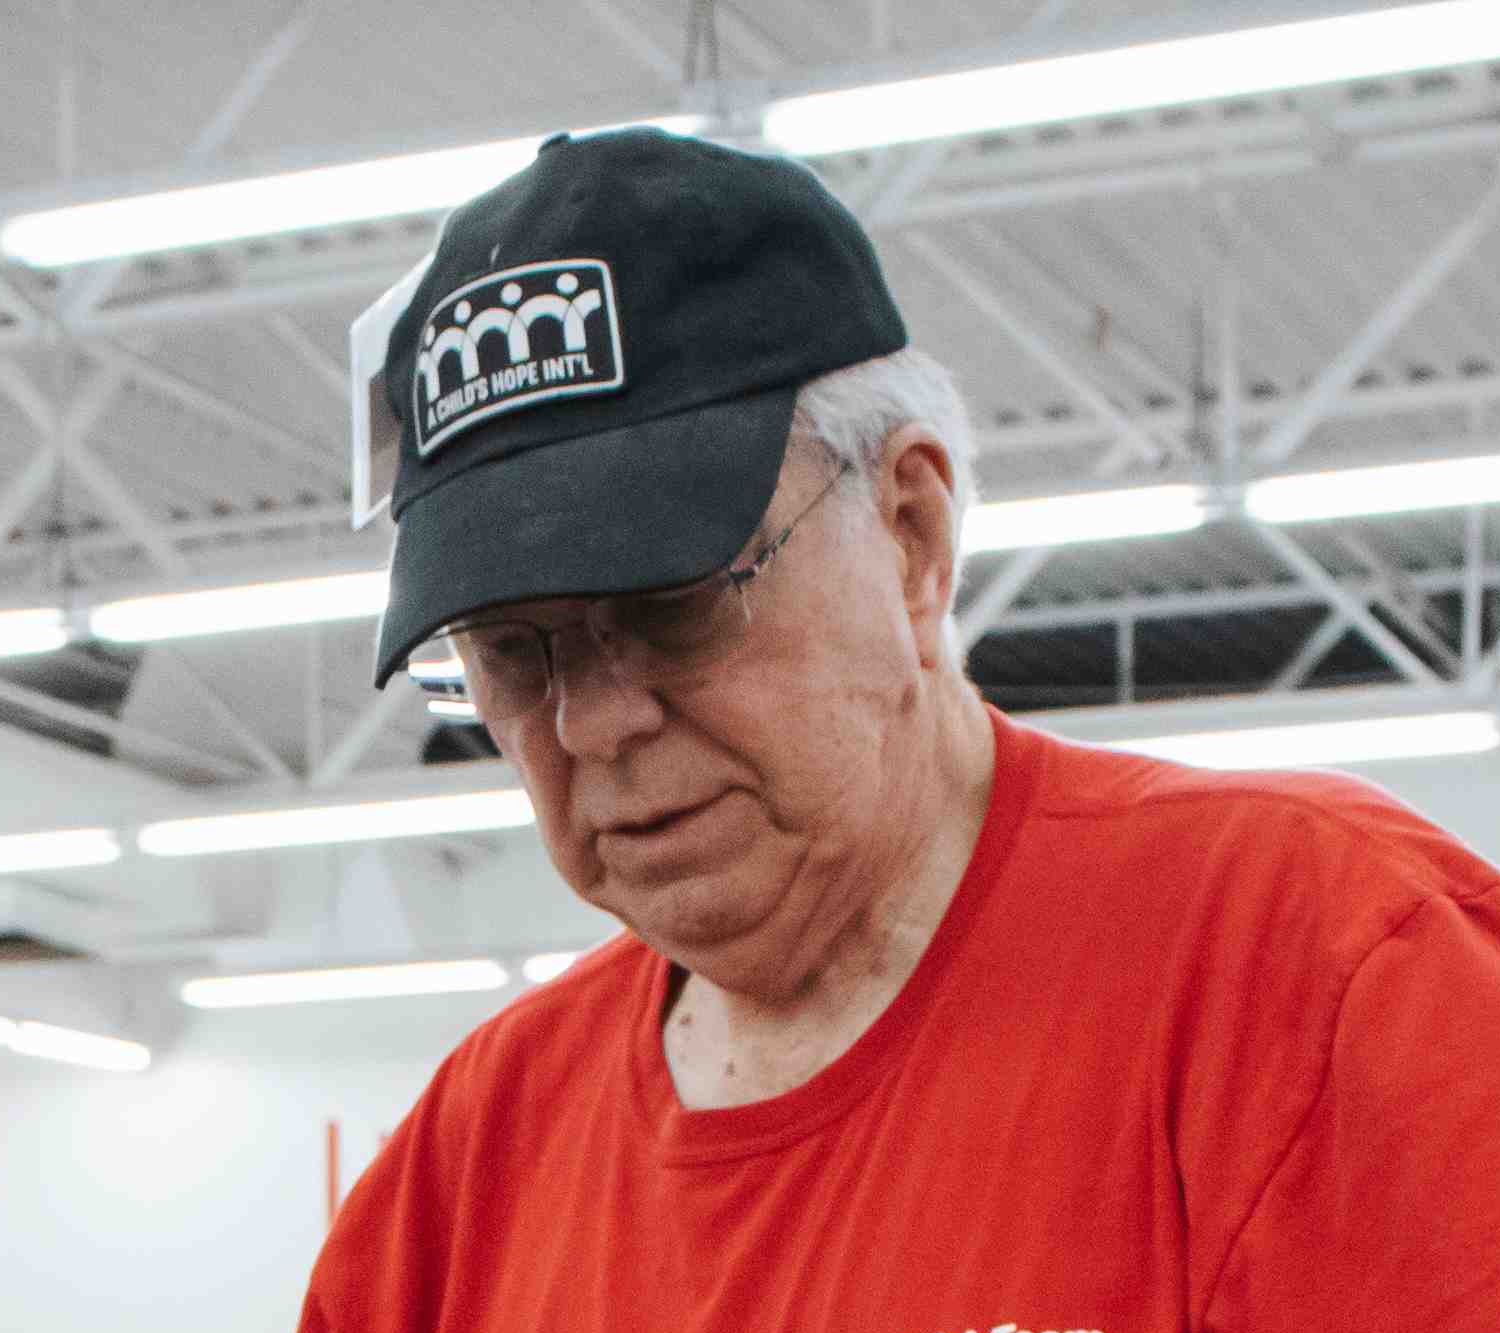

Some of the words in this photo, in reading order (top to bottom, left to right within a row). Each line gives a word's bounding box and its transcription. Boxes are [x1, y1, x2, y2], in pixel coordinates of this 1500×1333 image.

[436, 377, 489, 423] CHILD'S
[491, 361, 540, 396] HOPE
[542, 352, 594, 381] INT'L
